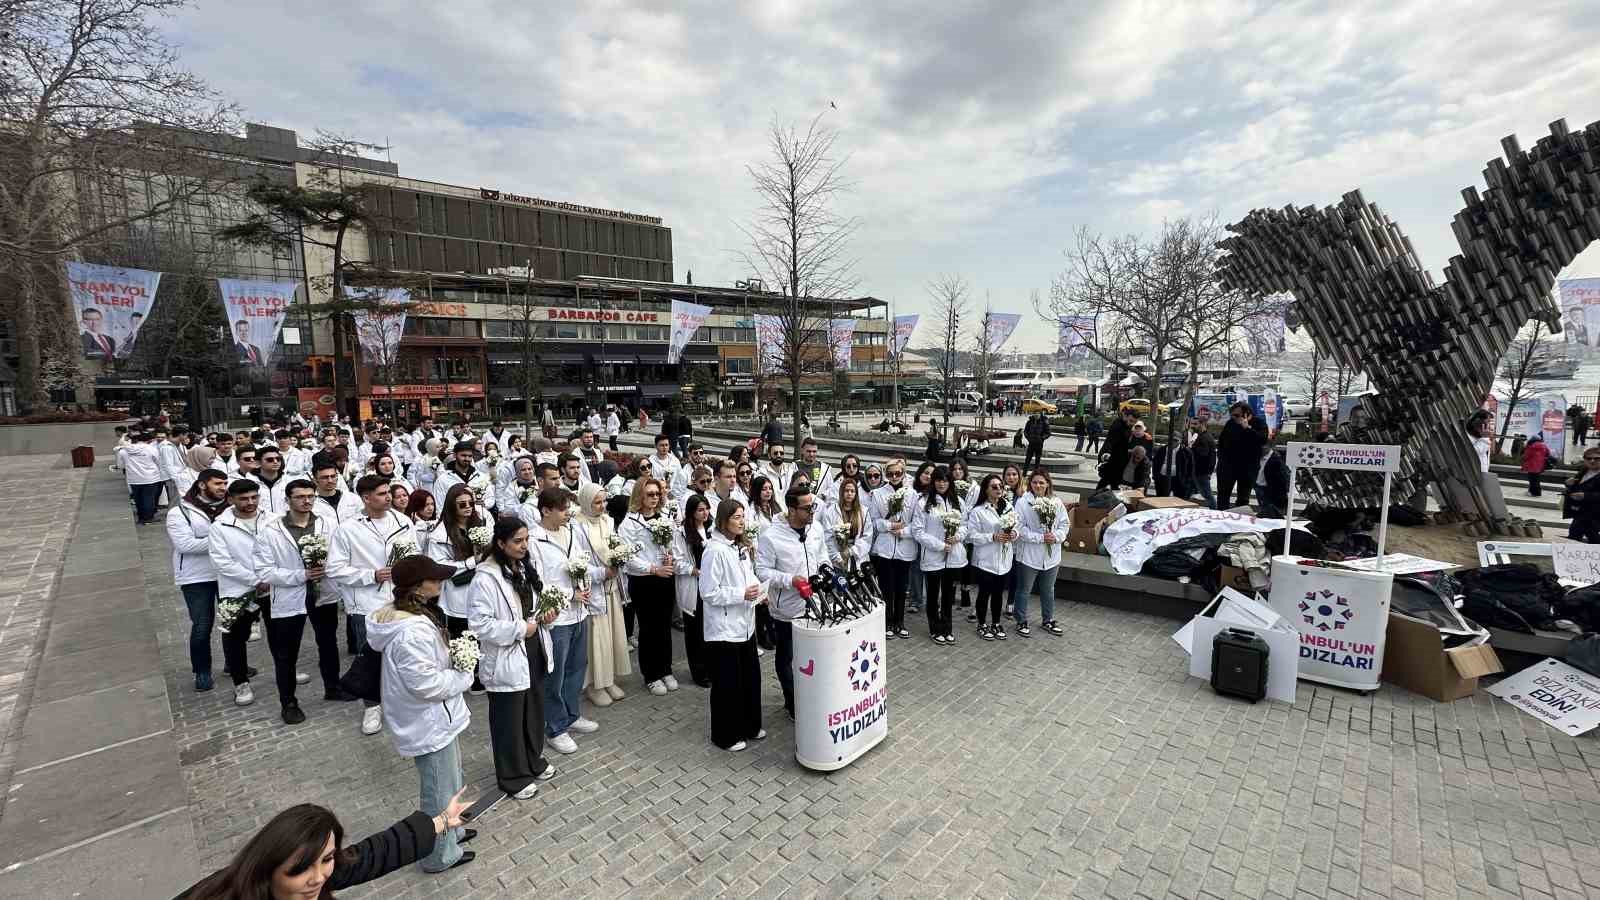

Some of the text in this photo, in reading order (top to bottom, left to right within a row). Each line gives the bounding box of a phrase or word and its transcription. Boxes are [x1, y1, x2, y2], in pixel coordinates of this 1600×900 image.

[548, 309, 658, 322] BARBAROS CAFE
[1327, 456, 1386, 466] YILDIZLARI
[1296, 631, 1375, 655] ANBUL'UN
[1299, 645, 1375, 670] DIZLARI
[829, 699, 888, 744] YILDIZLAR
